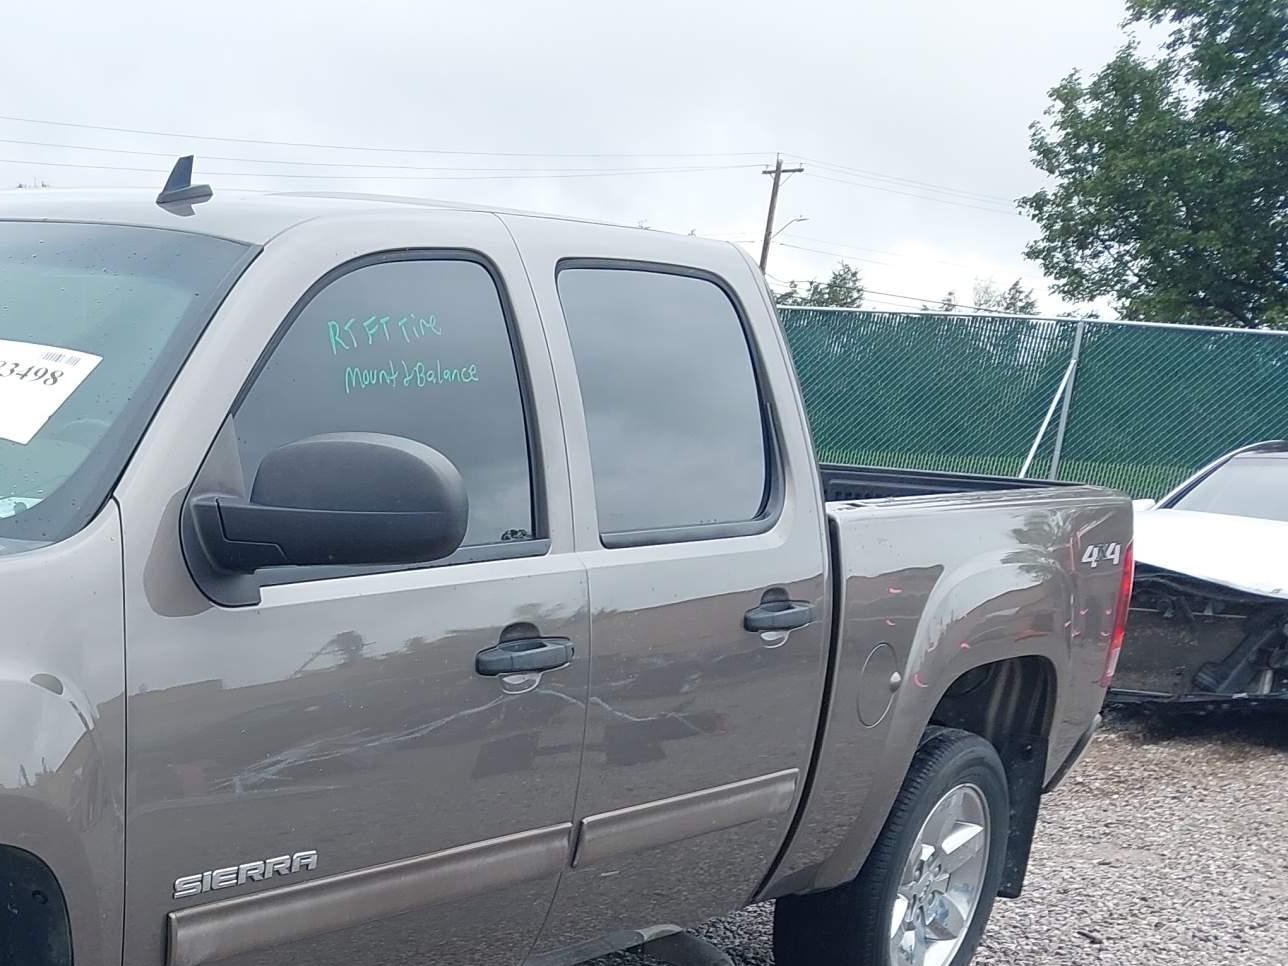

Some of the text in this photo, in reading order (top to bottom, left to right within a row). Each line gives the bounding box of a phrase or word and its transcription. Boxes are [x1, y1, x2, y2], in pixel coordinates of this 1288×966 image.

[327, 317, 357, 355] RT
[363, 315, 391, 345] FT
[345, 370, 398, 394] Mount
[414, 370, 480, 387] Balance
[172, 850, 318, 899] SIERRA
